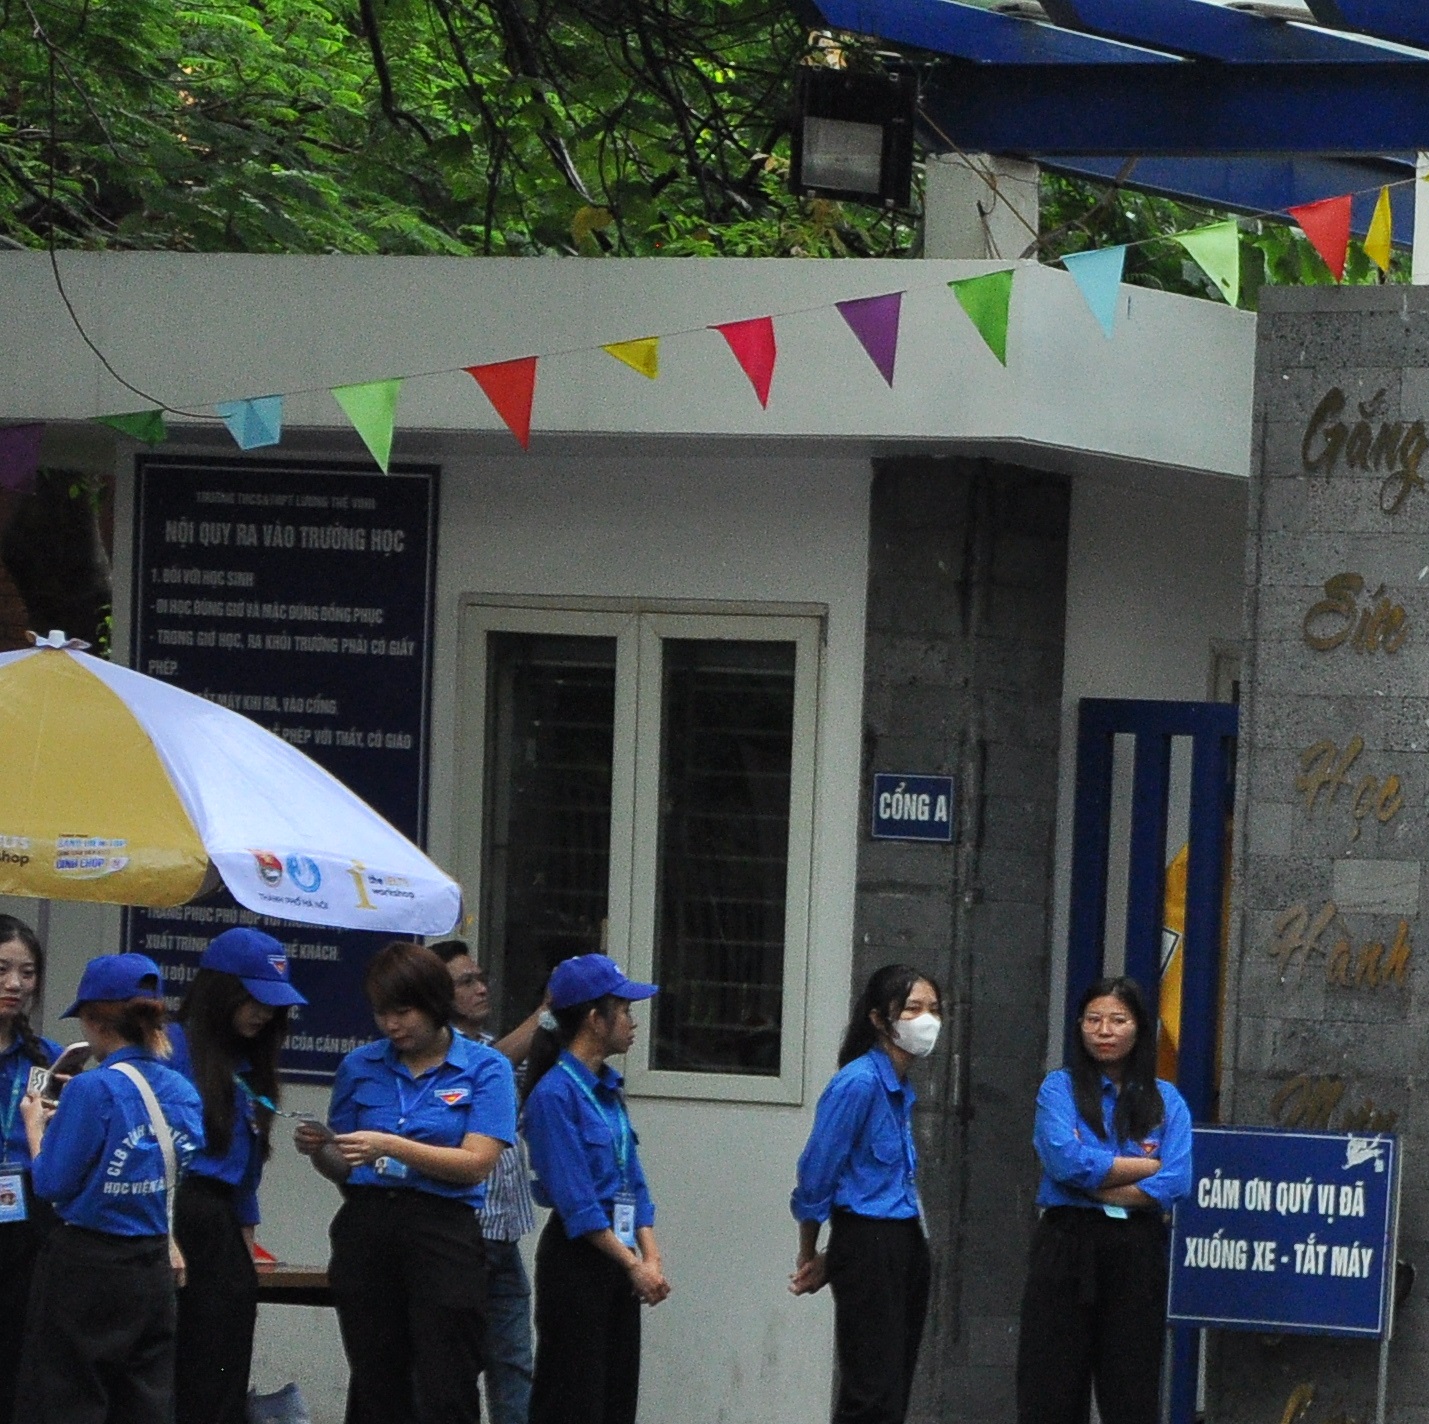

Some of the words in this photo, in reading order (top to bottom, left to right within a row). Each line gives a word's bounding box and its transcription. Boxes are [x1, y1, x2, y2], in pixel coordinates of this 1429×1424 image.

[1302, 386, 1429, 515] Gắng
[165, 516, 194, 548] NỘI
[199, 521, 231, 546] QUY
[236, 523, 258, 547] RA
[262, 519, 296, 548] VÀO
[299, 522, 366, 551] TRƯỜNG
[370, 528, 405, 557] HỌC
[879, 781, 930, 821] CỔNG
[934, 795, 947, 822] A
[1295, 735, 1403, 843] Học
[1270, 901, 1412, 990] Hành
[107, 1148, 129, 1177] CLB
[104, 1181, 131, 1197] HỌC
[1197, 1168, 1241, 1210] CẢM
[1245, 1177, 1272, 1212] ƠN
[1275, 1177, 1314, 1216] QUÝ
[1318, 1184, 1335, 1225] VỊ
[1338, 1180, 1366, 1218] ĐÃ
[1183, 1228, 1248, 1271] XUỐNG
[1251, 1241, 1277, 1272] XE
[1293, 1232, 1329, 1276] TẮT
[1330, 1240, 1374, 1279] MÁY
